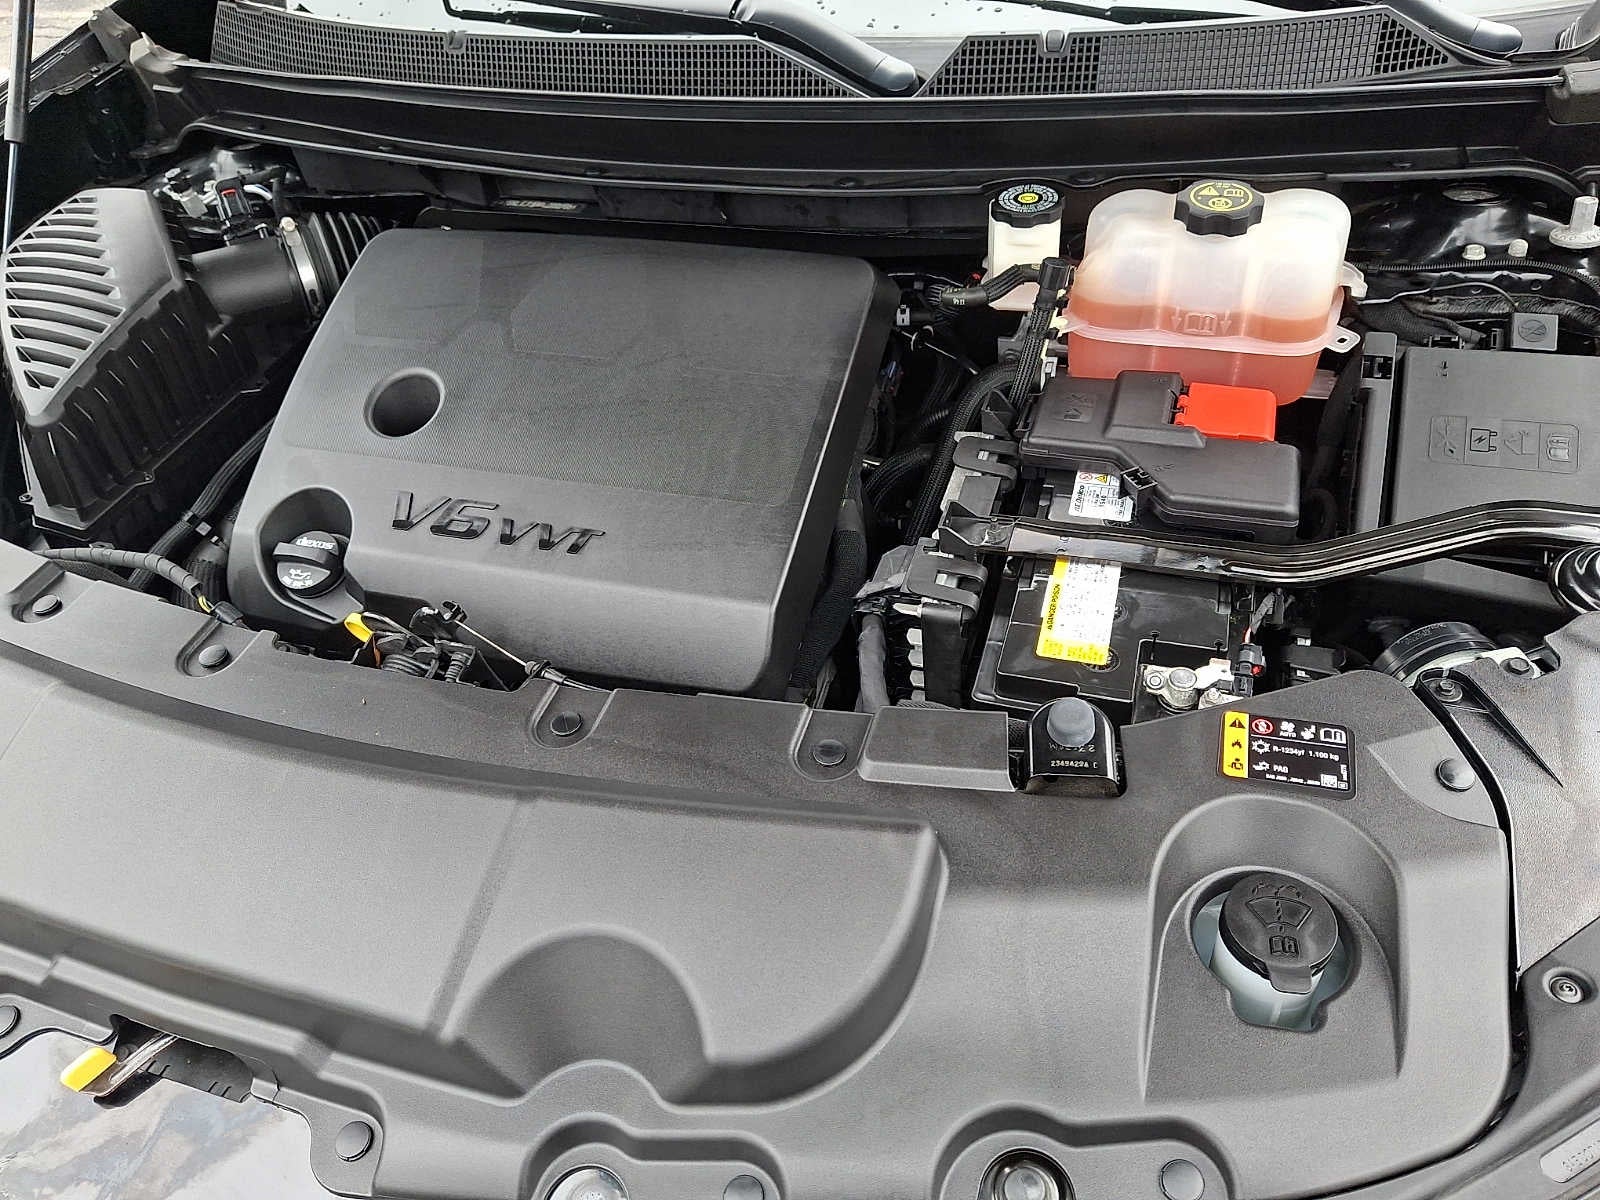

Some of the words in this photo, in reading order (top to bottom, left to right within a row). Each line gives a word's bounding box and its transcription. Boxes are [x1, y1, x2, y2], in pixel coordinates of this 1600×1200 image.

[391, 490, 499, 540] V6
[499, 517, 606, 555] VVT
[296, 537, 336, 550] dexos
[1272, 745, 1305, 757] R-1234yf
[1308, 750, 1329, 759] 1.100
[1329, 753, 1340, 762] kg
[1273, 763, 1289, 774] PAG
